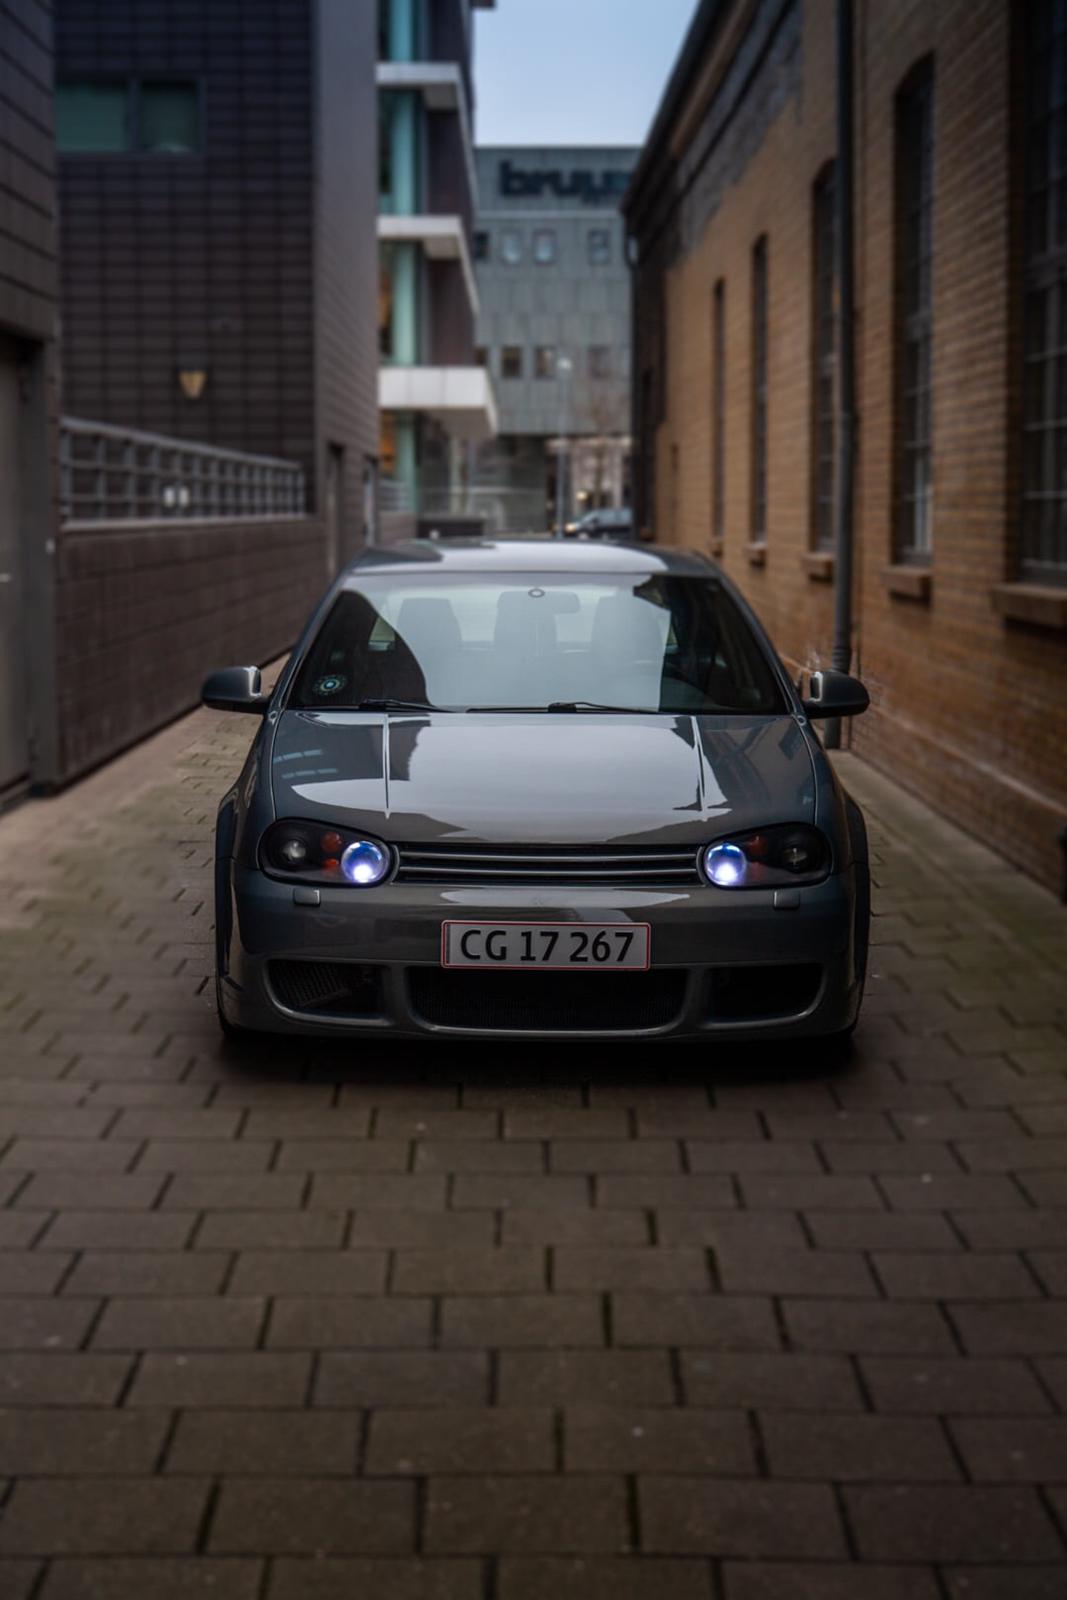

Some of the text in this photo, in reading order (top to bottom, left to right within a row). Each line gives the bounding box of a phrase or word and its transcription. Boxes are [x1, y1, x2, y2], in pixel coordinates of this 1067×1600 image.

[460, 929, 634, 963] CG 17 267
